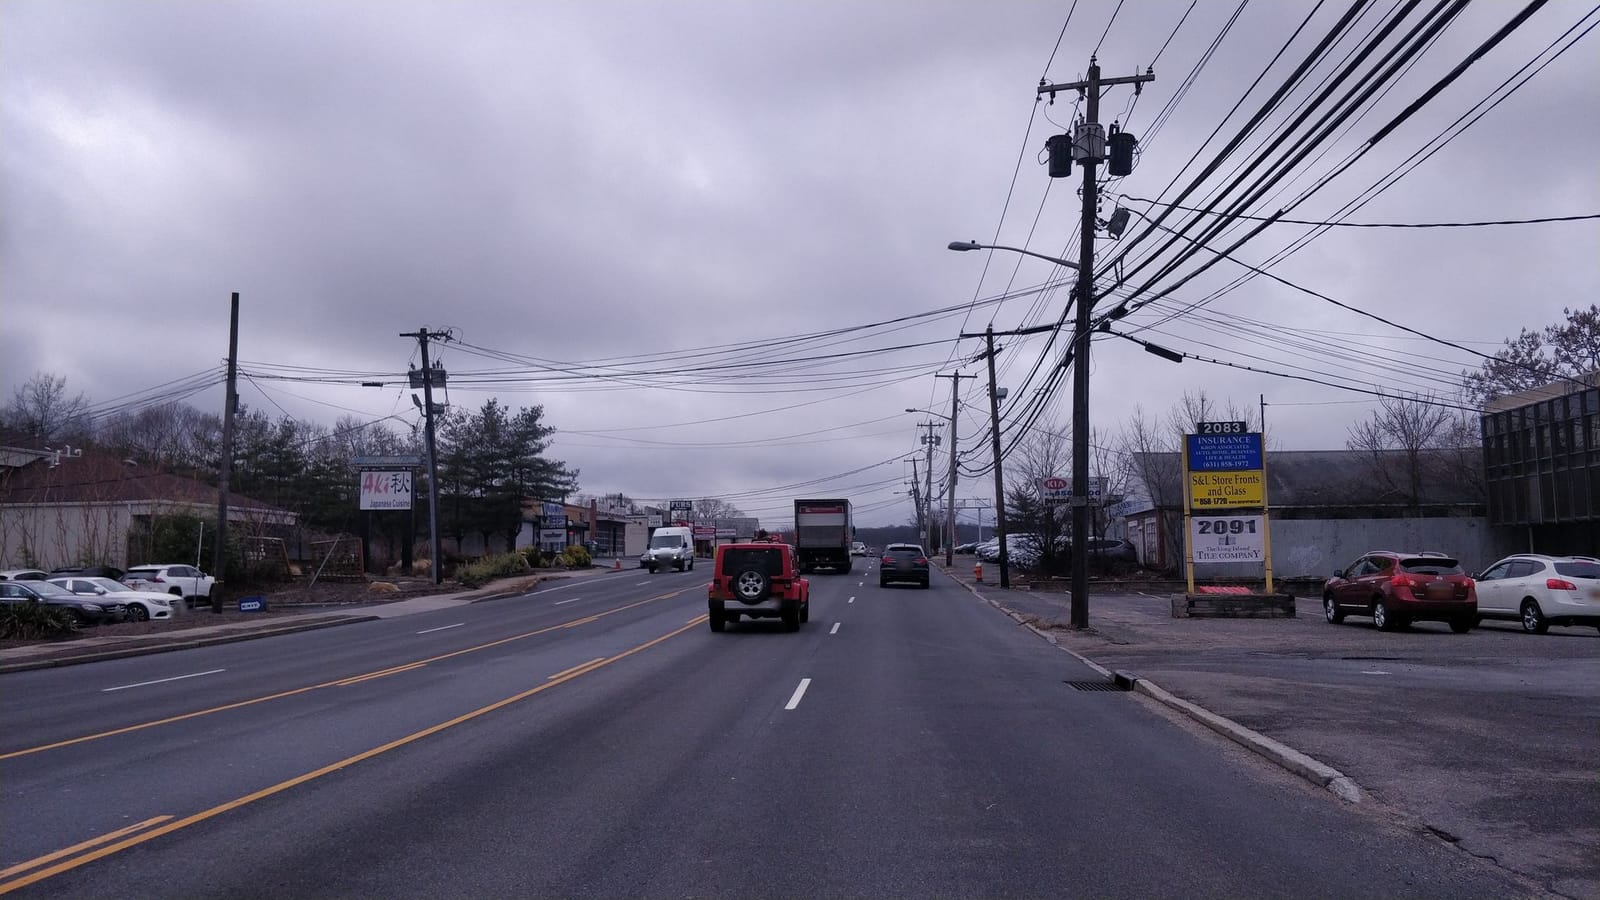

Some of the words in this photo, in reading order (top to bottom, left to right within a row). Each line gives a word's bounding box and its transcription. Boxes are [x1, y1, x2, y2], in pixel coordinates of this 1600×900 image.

[1203, 422, 1241, 433] 2083
[1198, 436, 1252, 445] INSURANCE
[362, 472, 390, 496] Aki
[390, 472, 410, 494] 秋
[1047, 480, 1065, 488] KIA
[1192, 476, 1209, 486] S&L
[1212, 475, 1232, 485] Store
[1234, 474, 1260, 484] Fronts
[1208, 486, 1222, 496] and
[1224, 486, 1247, 496] Glass
[370, 499, 392, 508] Japanese
[392, 499, 410, 508] Cuisine
[1198, 519, 1256, 535] 2091
[1196, 551, 1218, 560] TILE
[1219, 550, 1261, 559] COMPANY
